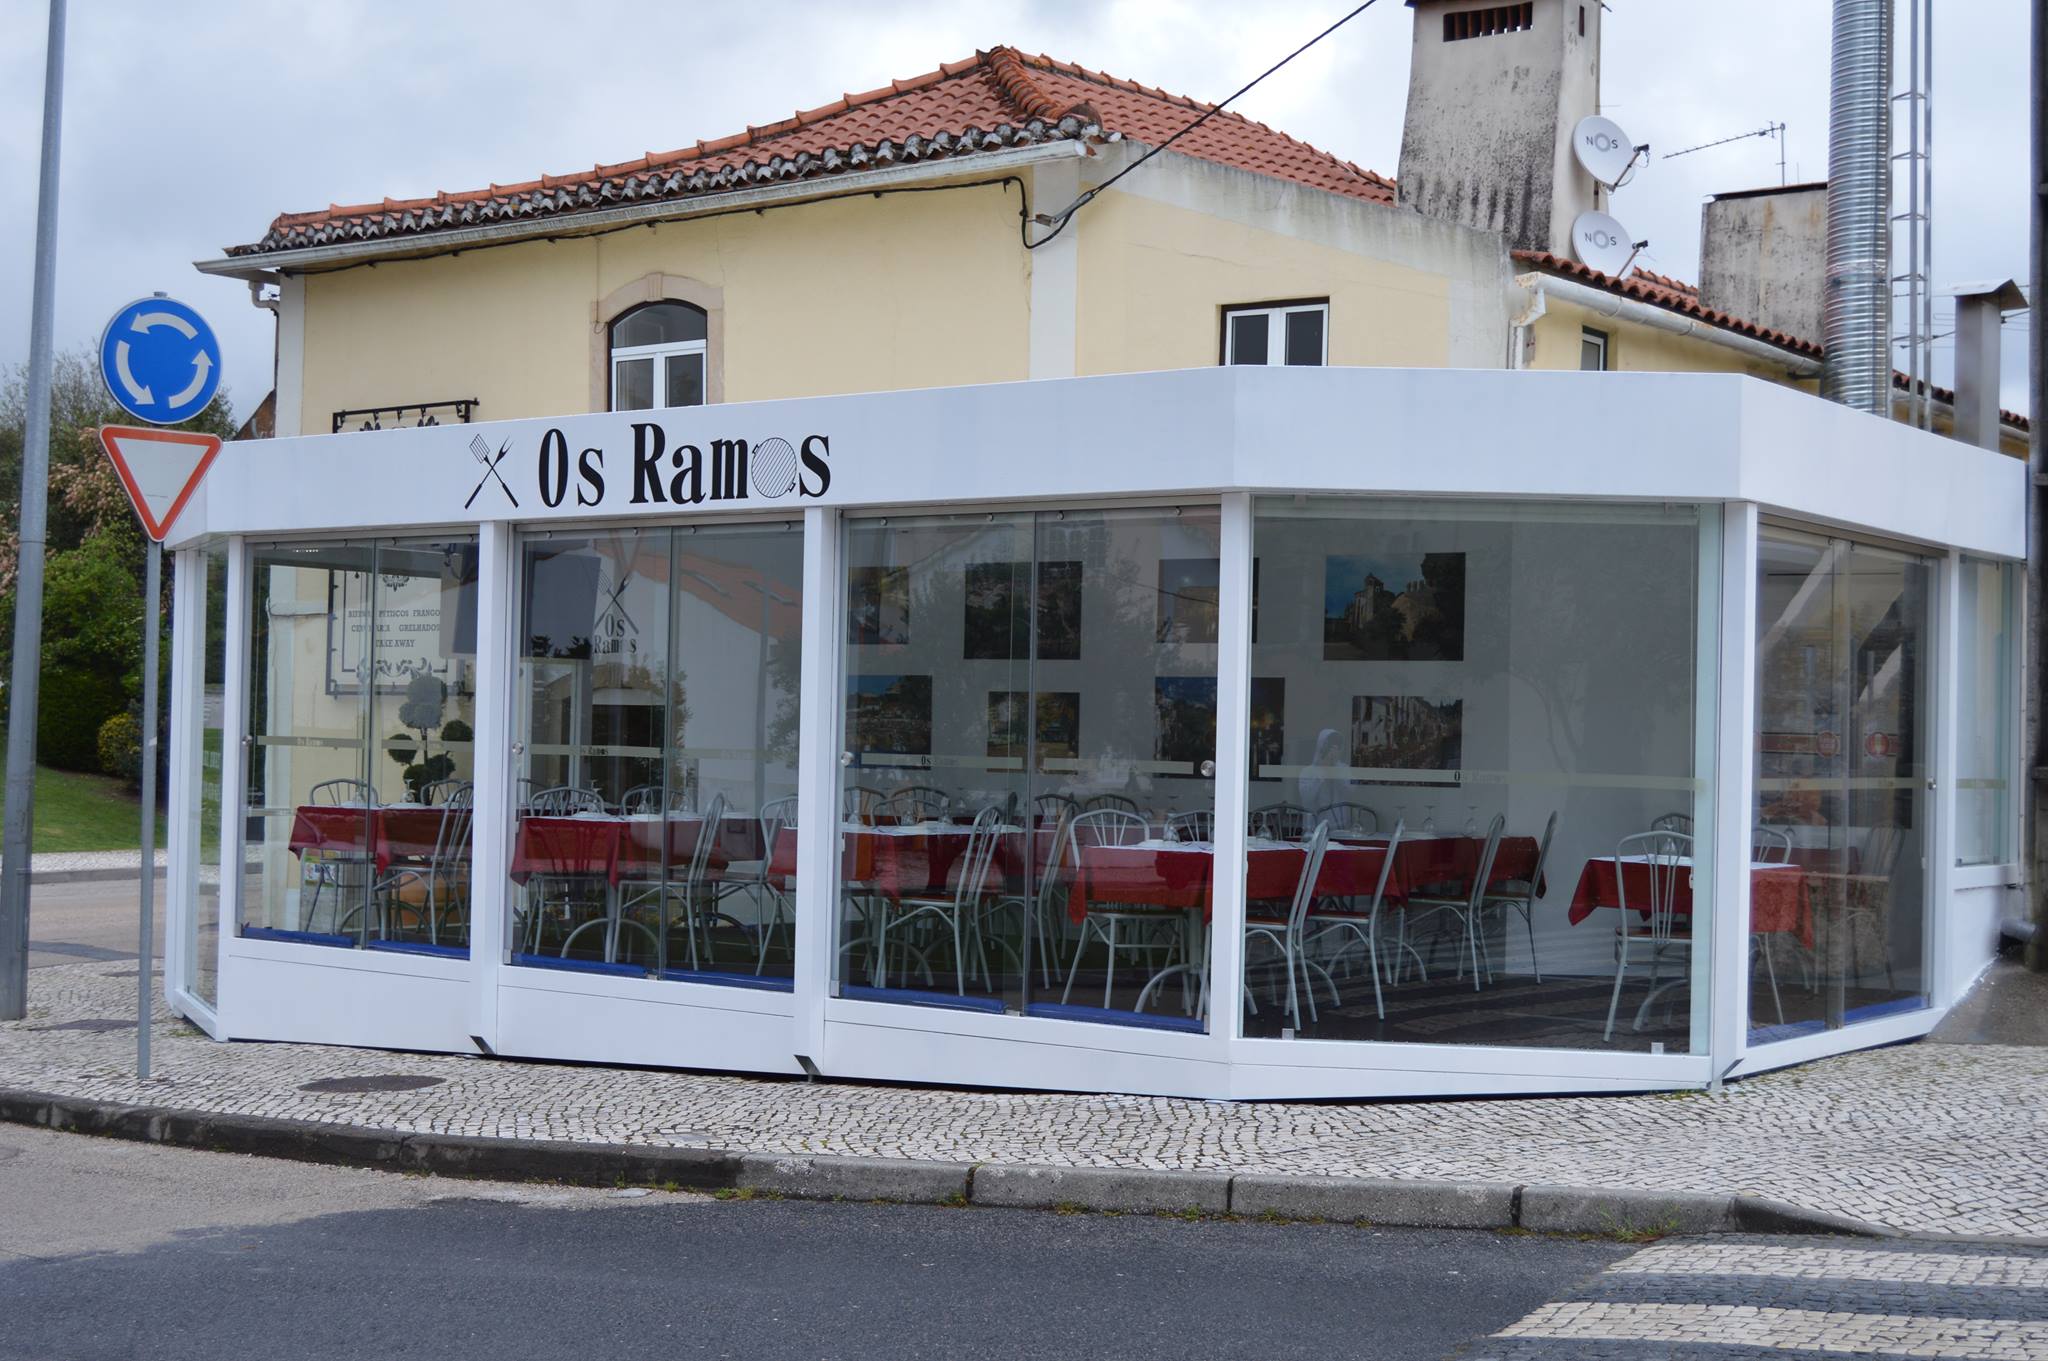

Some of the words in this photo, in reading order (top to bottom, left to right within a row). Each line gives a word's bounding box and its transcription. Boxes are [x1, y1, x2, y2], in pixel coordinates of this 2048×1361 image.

[1585, 132, 1619, 152] NOS
[1584, 229, 1617, 249] NOS
[538, 427, 606, 509] Os
[629, 422, 832, 506] Ramos
[604, 612, 626, 638] Os
[593, 635, 637, 654] Rams
